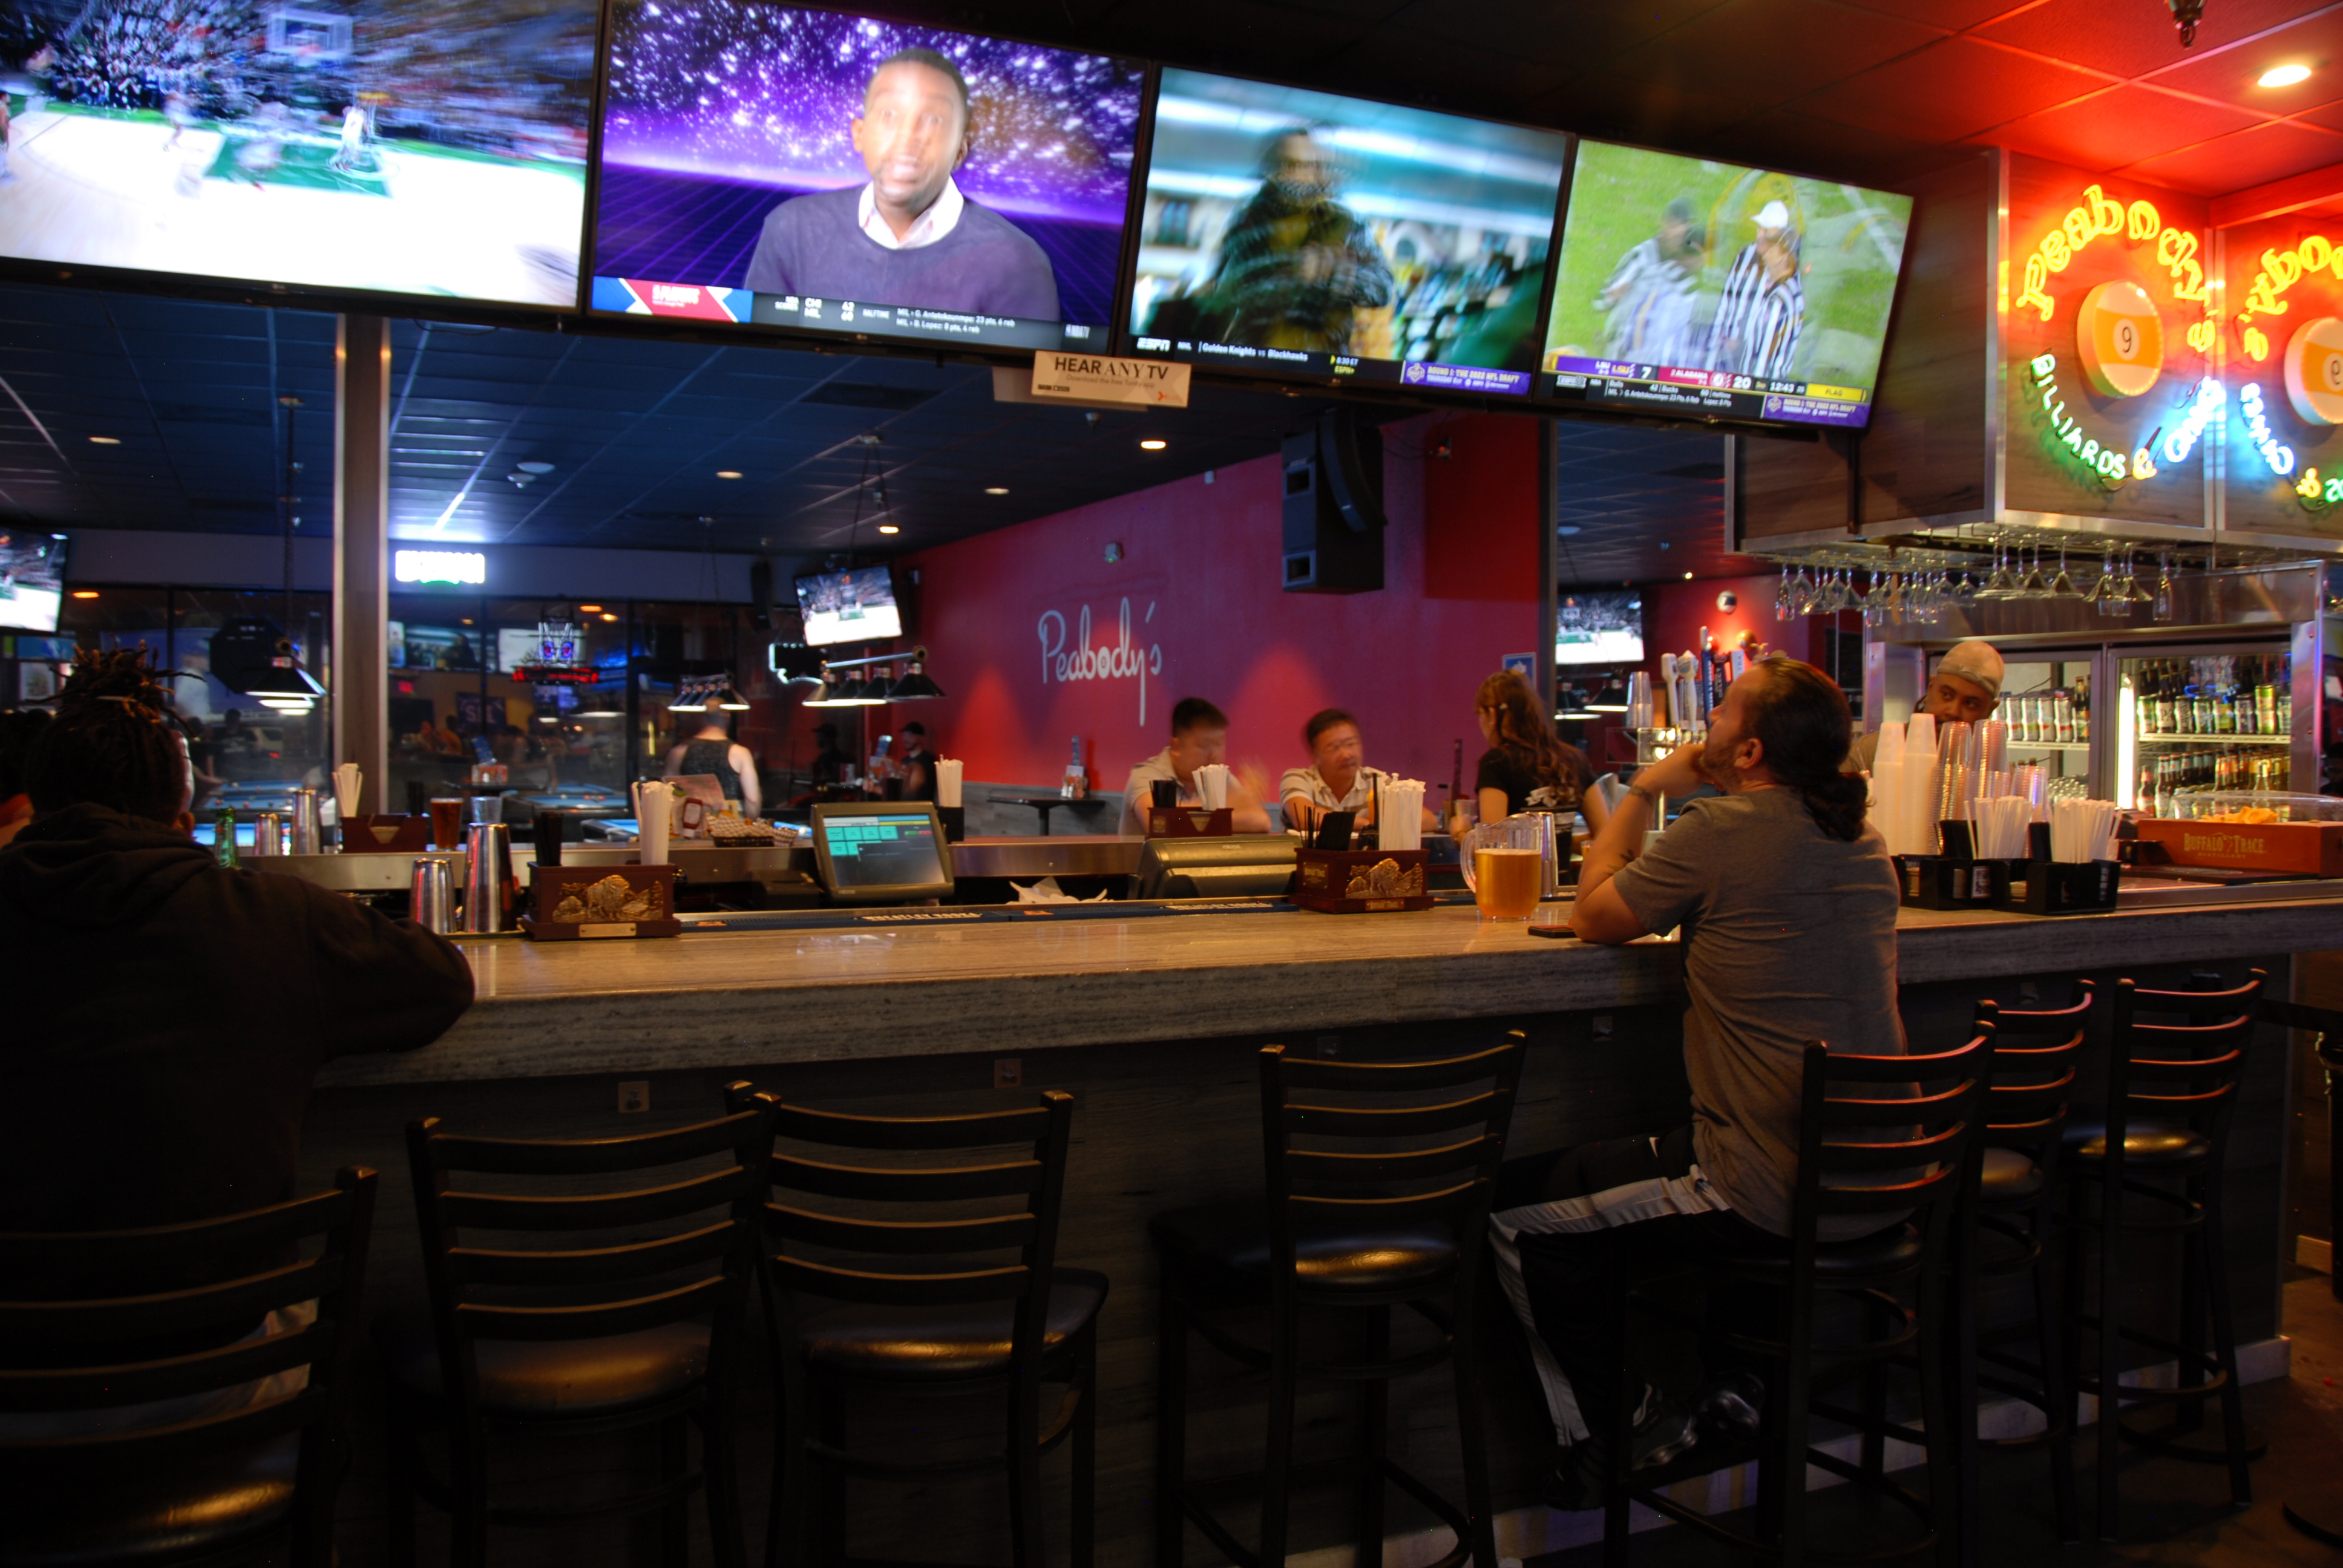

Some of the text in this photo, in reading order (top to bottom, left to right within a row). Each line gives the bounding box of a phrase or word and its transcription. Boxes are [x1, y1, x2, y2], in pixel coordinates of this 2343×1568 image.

[2016, 185, 2216, 352] Peabody's
[804, 308, 821, 318] MIL
[805, 298, 822, 309] CHI
[862, 309, 890, 319] HALFTIME
[1137, 337, 1170, 351] ESPN
[2122, 326, 2132, 353] 9
[1178, 341, 1192, 351] NHL
[1202, 342, 1228, 354] Golden
[1228, 345, 1256, 357] Knights
[1267, 348, 1308, 362] Blackhawks
[1055, 356, 1168, 379] HEAR ANY TV
[1066, 373, 1098, 383] Download
[1456, 369, 1469, 377] THE
[1486, 372, 1498, 381] NFL
[1499, 373, 1519, 383] DRAFT
[1595, 361, 1610, 370] LSU
[1611, 365, 1630, 374] LSU
[1641, 366, 1652, 379] 7
[1676, 370, 1708, 379] ALABAMA
[1732, 376, 1752, 390] 20
[1770, 382, 1795, 393] 12:43
[2031, 354, 2126, 480] BILLIARDS
[2133, 448, 2157, 480] &
[1038, 596, 1162, 727] Peabody's
[2184, 833, 2264, 854] BUFFALO TRACE
